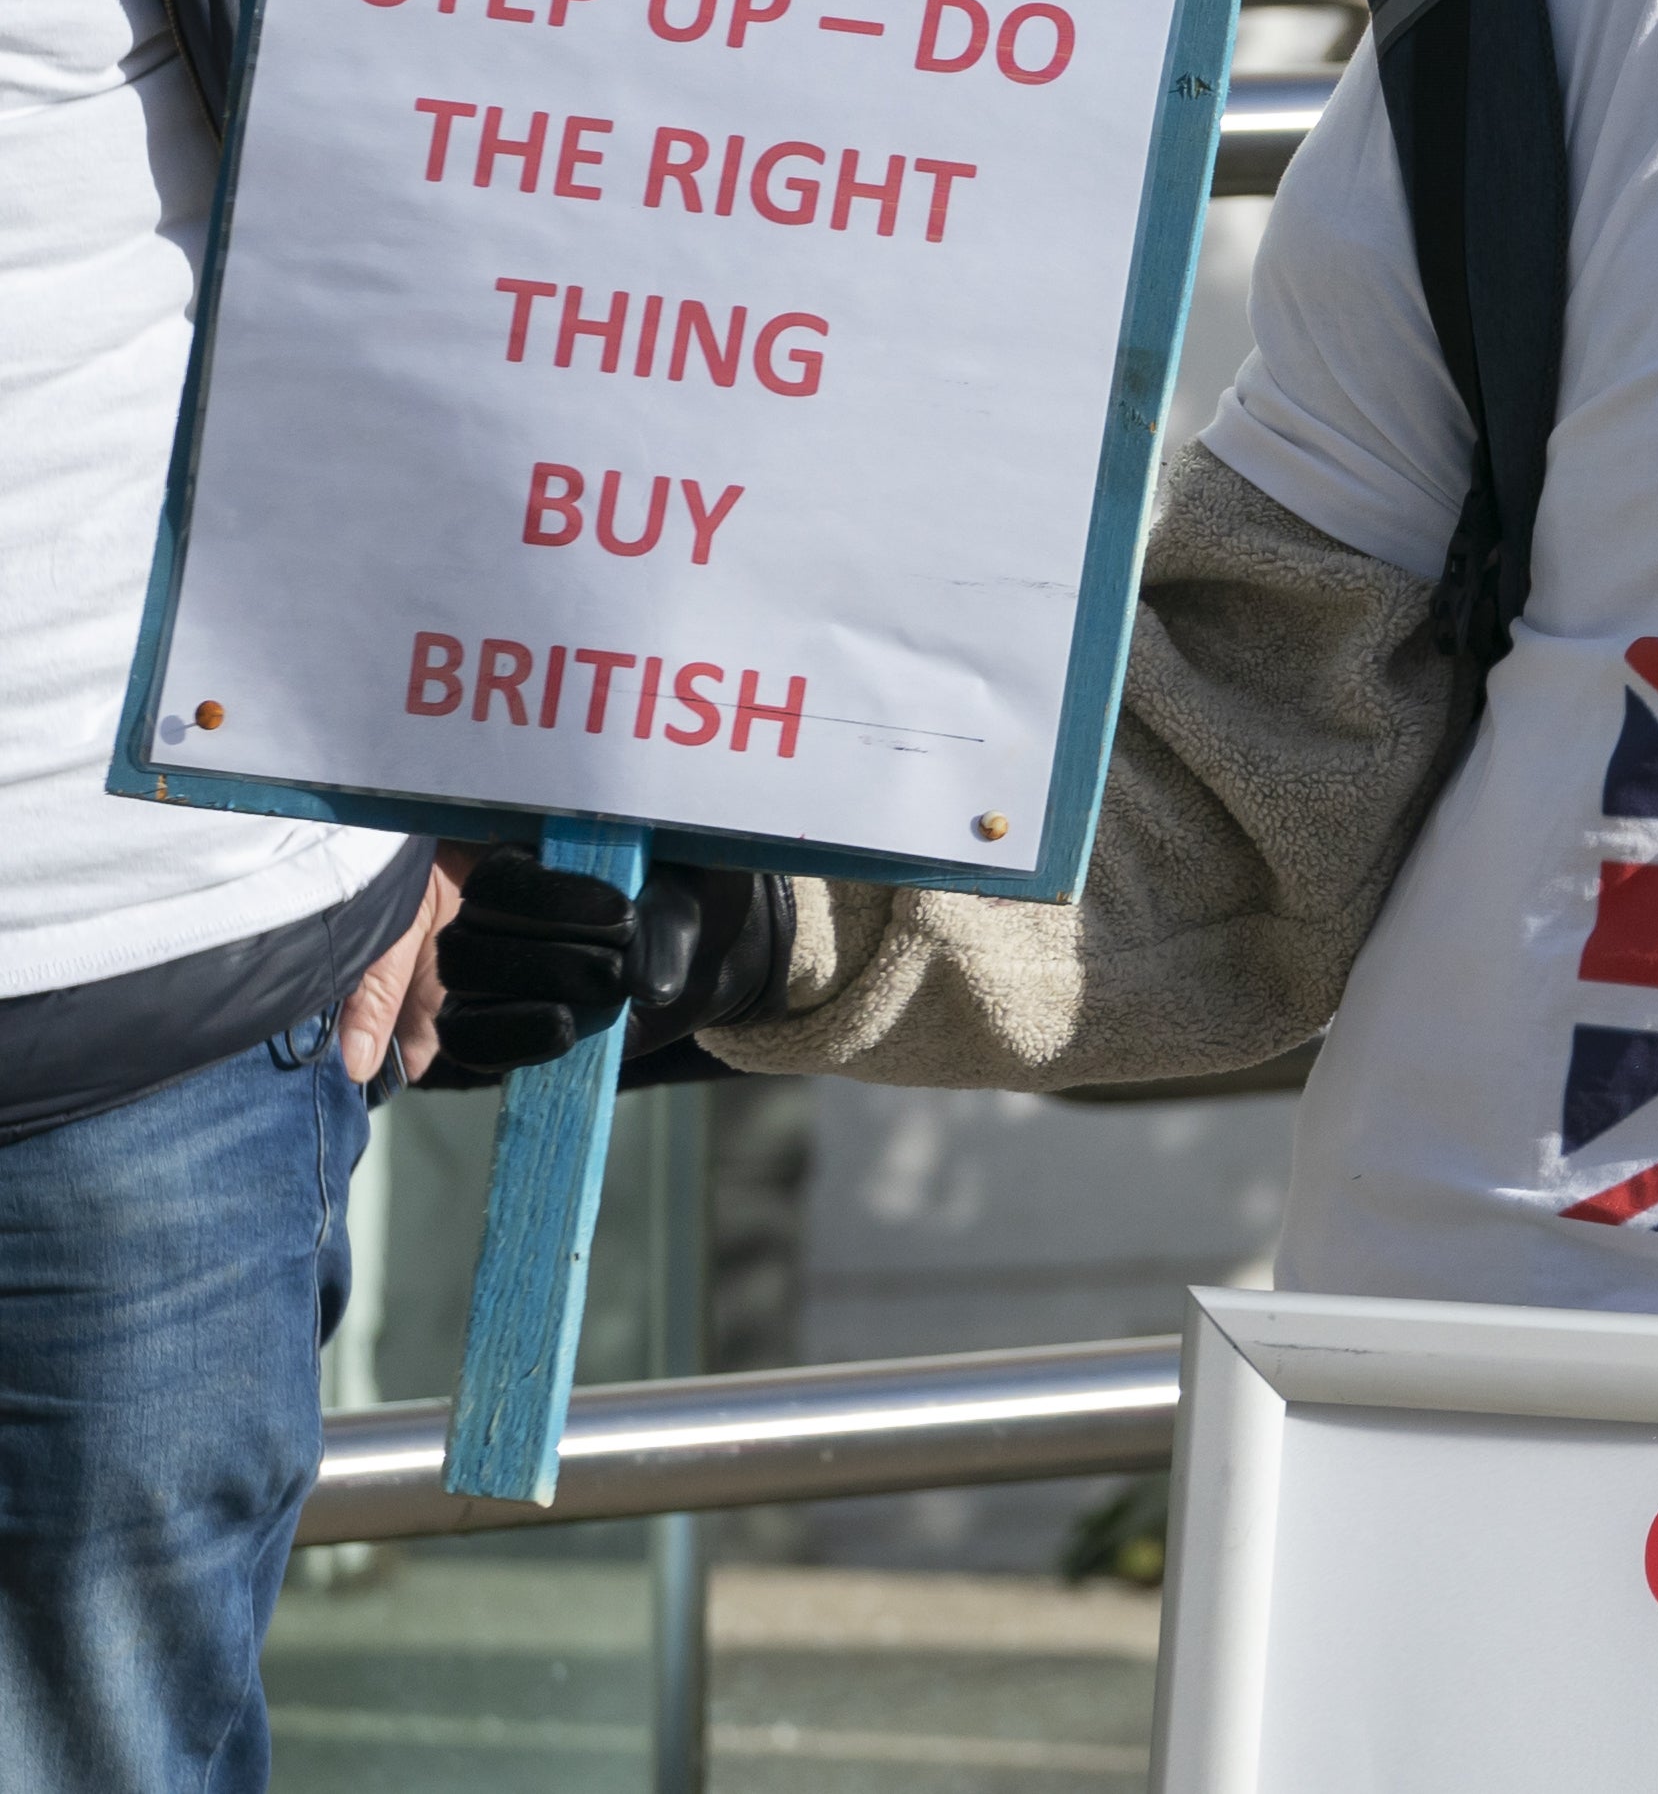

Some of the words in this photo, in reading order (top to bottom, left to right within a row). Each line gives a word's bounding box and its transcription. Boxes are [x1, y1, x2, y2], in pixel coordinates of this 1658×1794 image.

[416, 98, 613, 200] THE
[644, 127, 977, 243] RIGHT
[496, 278, 829, 397] THING
[524, 463, 744, 565] BUY
[406, 632, 807, 759] BRITISH
